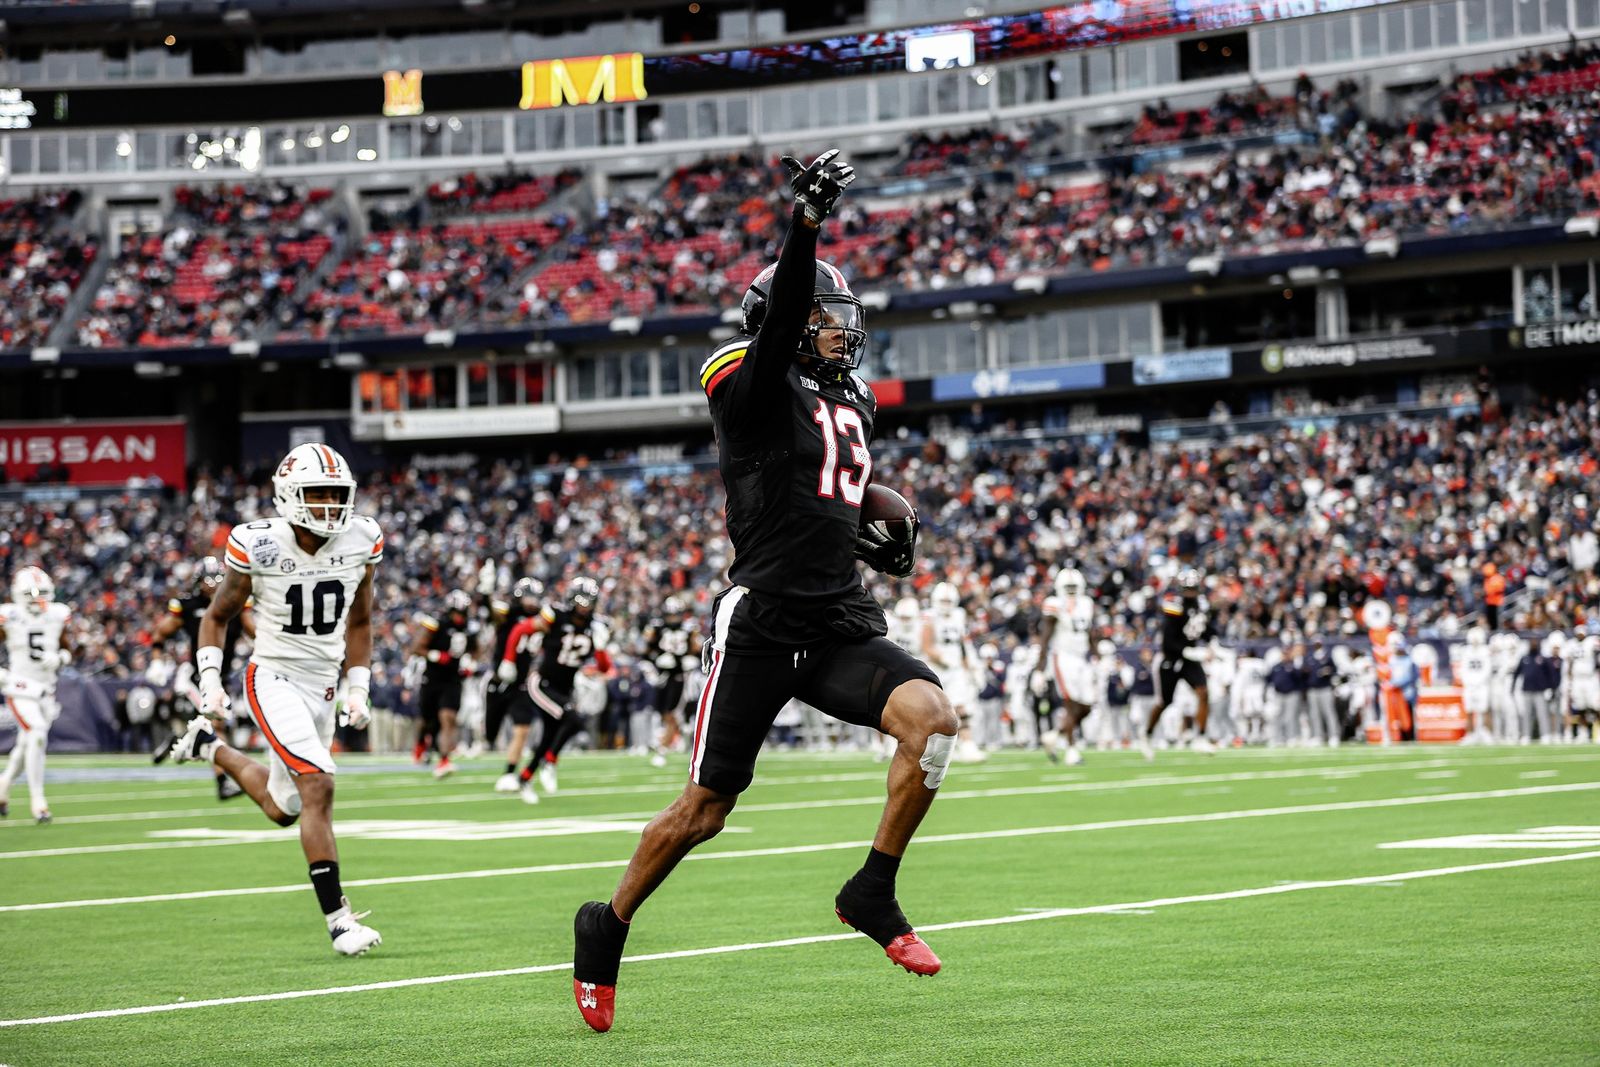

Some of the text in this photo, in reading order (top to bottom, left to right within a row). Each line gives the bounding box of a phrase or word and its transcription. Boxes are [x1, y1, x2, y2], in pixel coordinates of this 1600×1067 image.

[813, 397, 872, 507] 13
[282, 580, 344, 635] 10
[29, 632, 45, 661] 5
